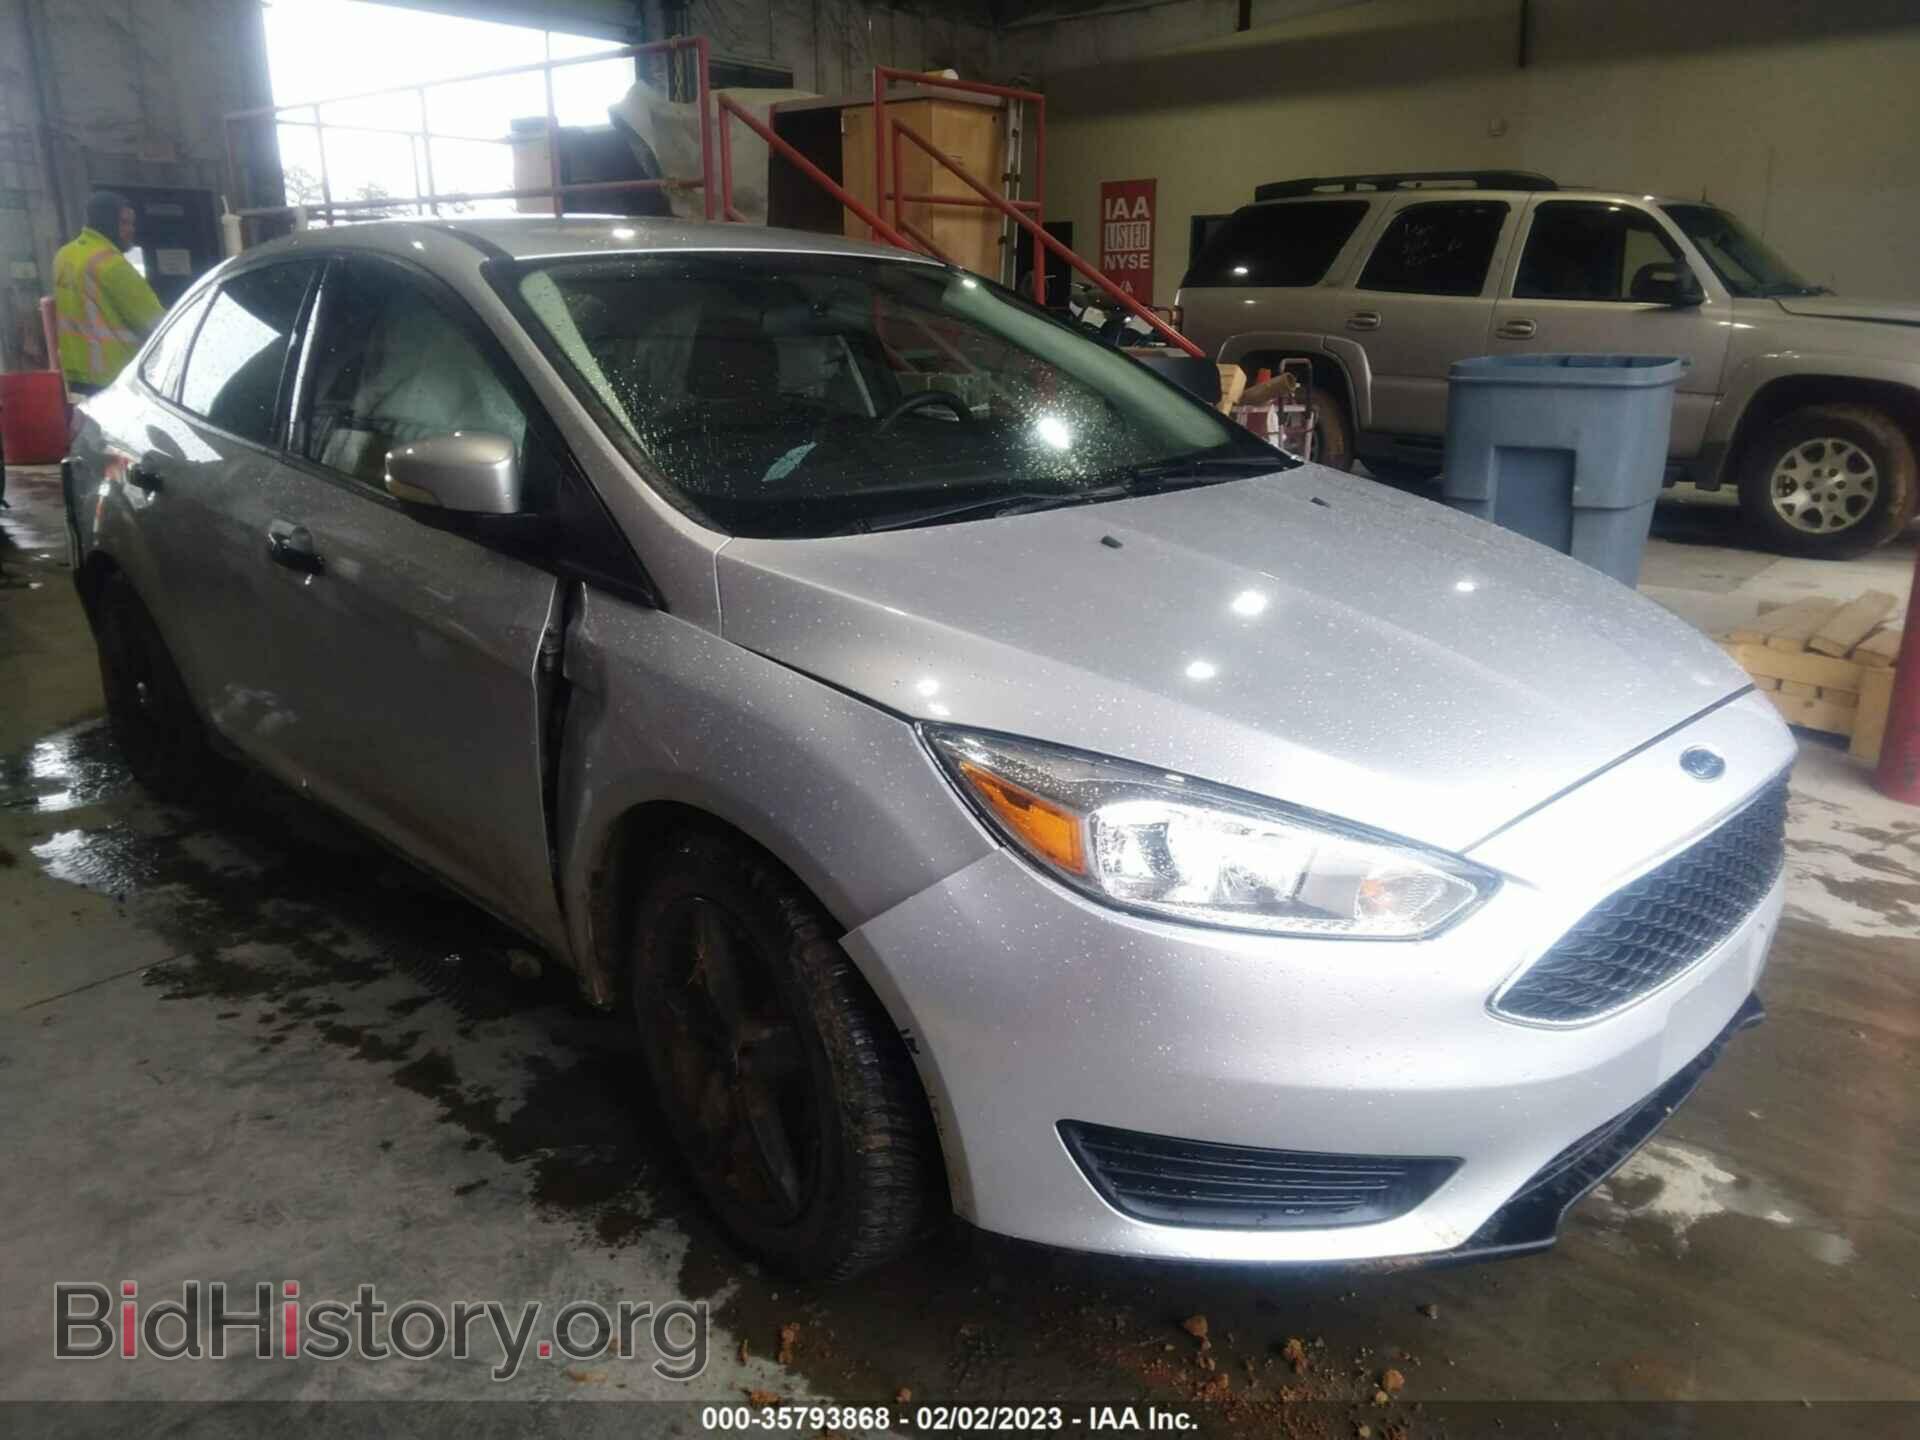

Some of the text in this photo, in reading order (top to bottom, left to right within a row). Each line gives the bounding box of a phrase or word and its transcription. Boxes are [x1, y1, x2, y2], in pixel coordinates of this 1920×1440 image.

[1105, 196, 1151, 220] IAA
[1107, 223, 1149, 250] LISTED
[1104, 253, 1151, 270] NYSE
